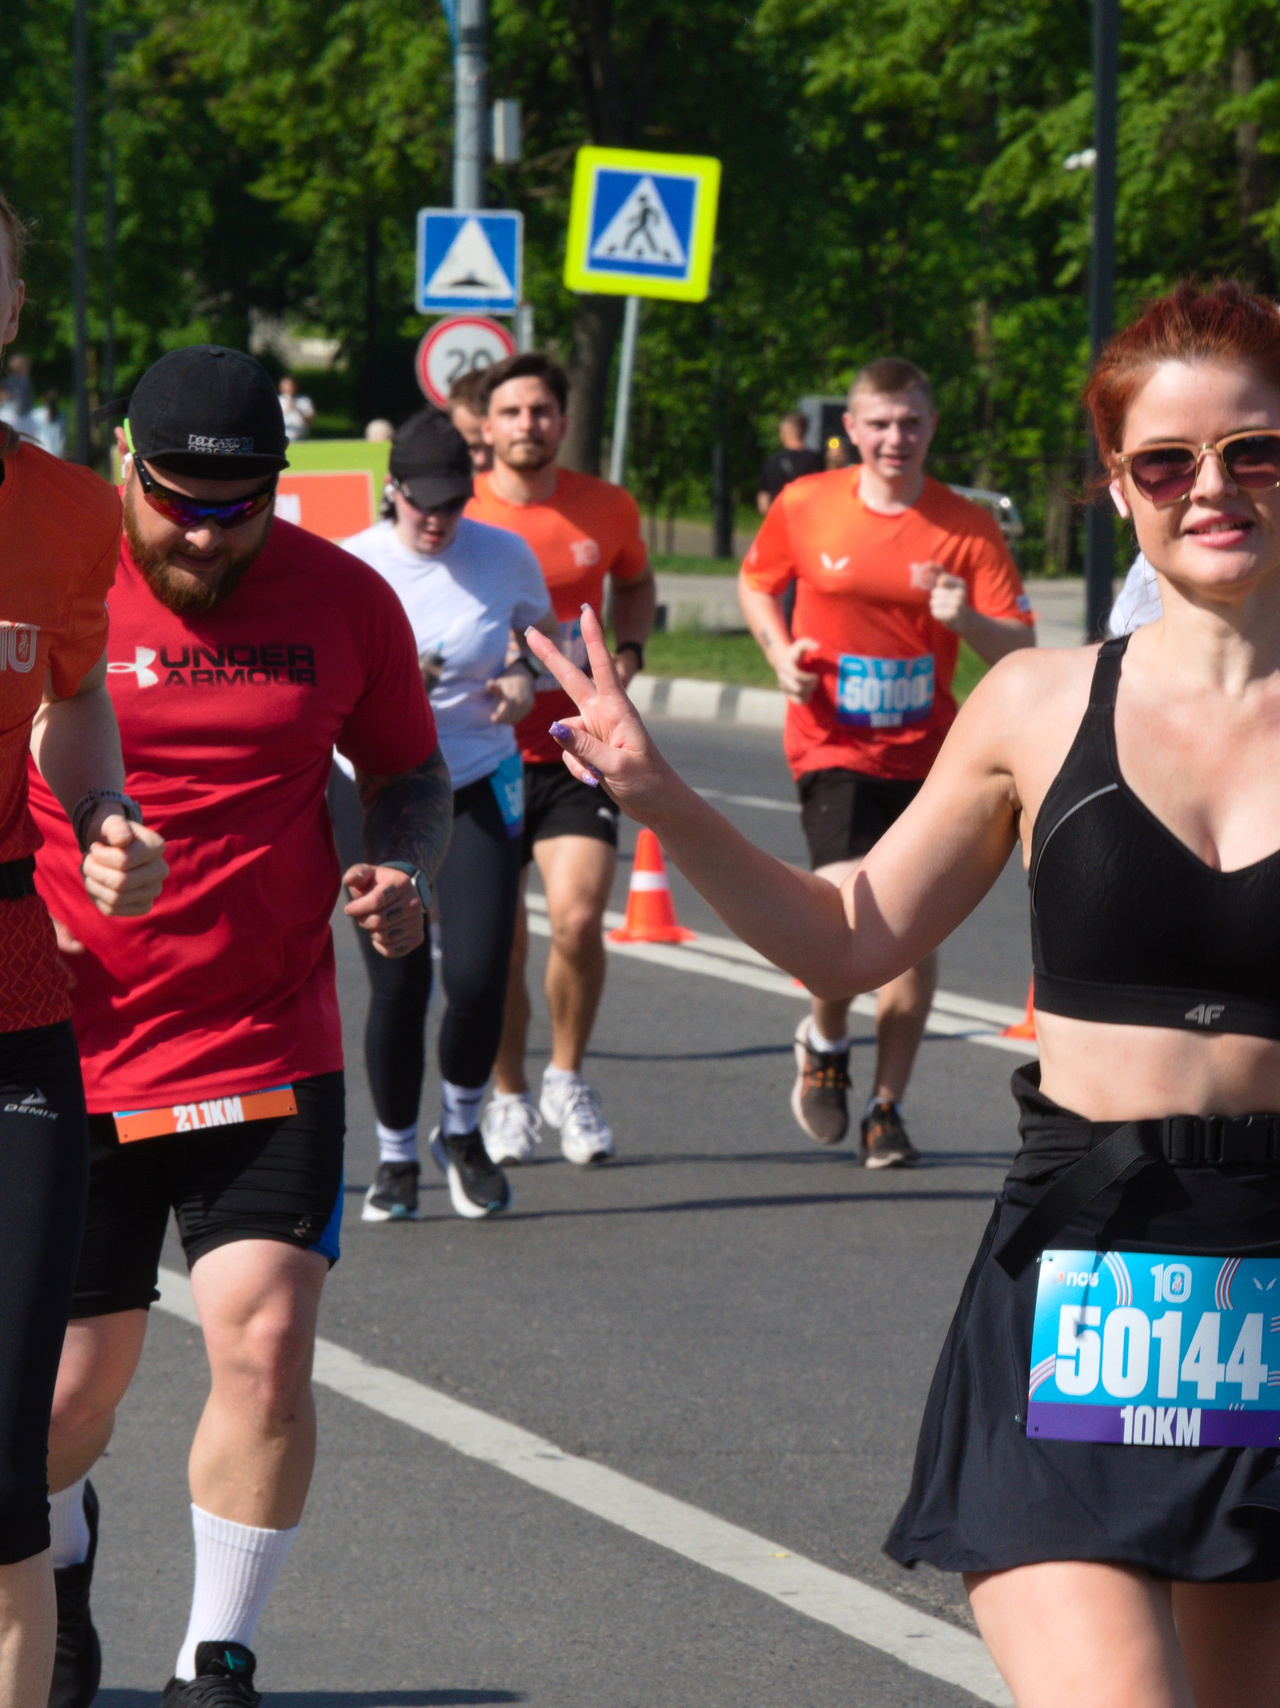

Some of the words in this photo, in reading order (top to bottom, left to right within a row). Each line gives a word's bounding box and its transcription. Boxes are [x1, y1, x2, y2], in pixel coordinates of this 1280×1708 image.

[160, 643, 315, 668] UNDER
[164, 668, 316, 687] ARMOUR
[1184, 1003, 1225, 1026] 4F
[3, 1103, 59, 1120] DEMIX
[172, 1094, 245, 1133] 21.1KM
[1150, 1263, 1192, 1303] 10
[1055, 1304, 1268, 1401] 50144
[1120, 1404, 1202, 1447] 10KM
